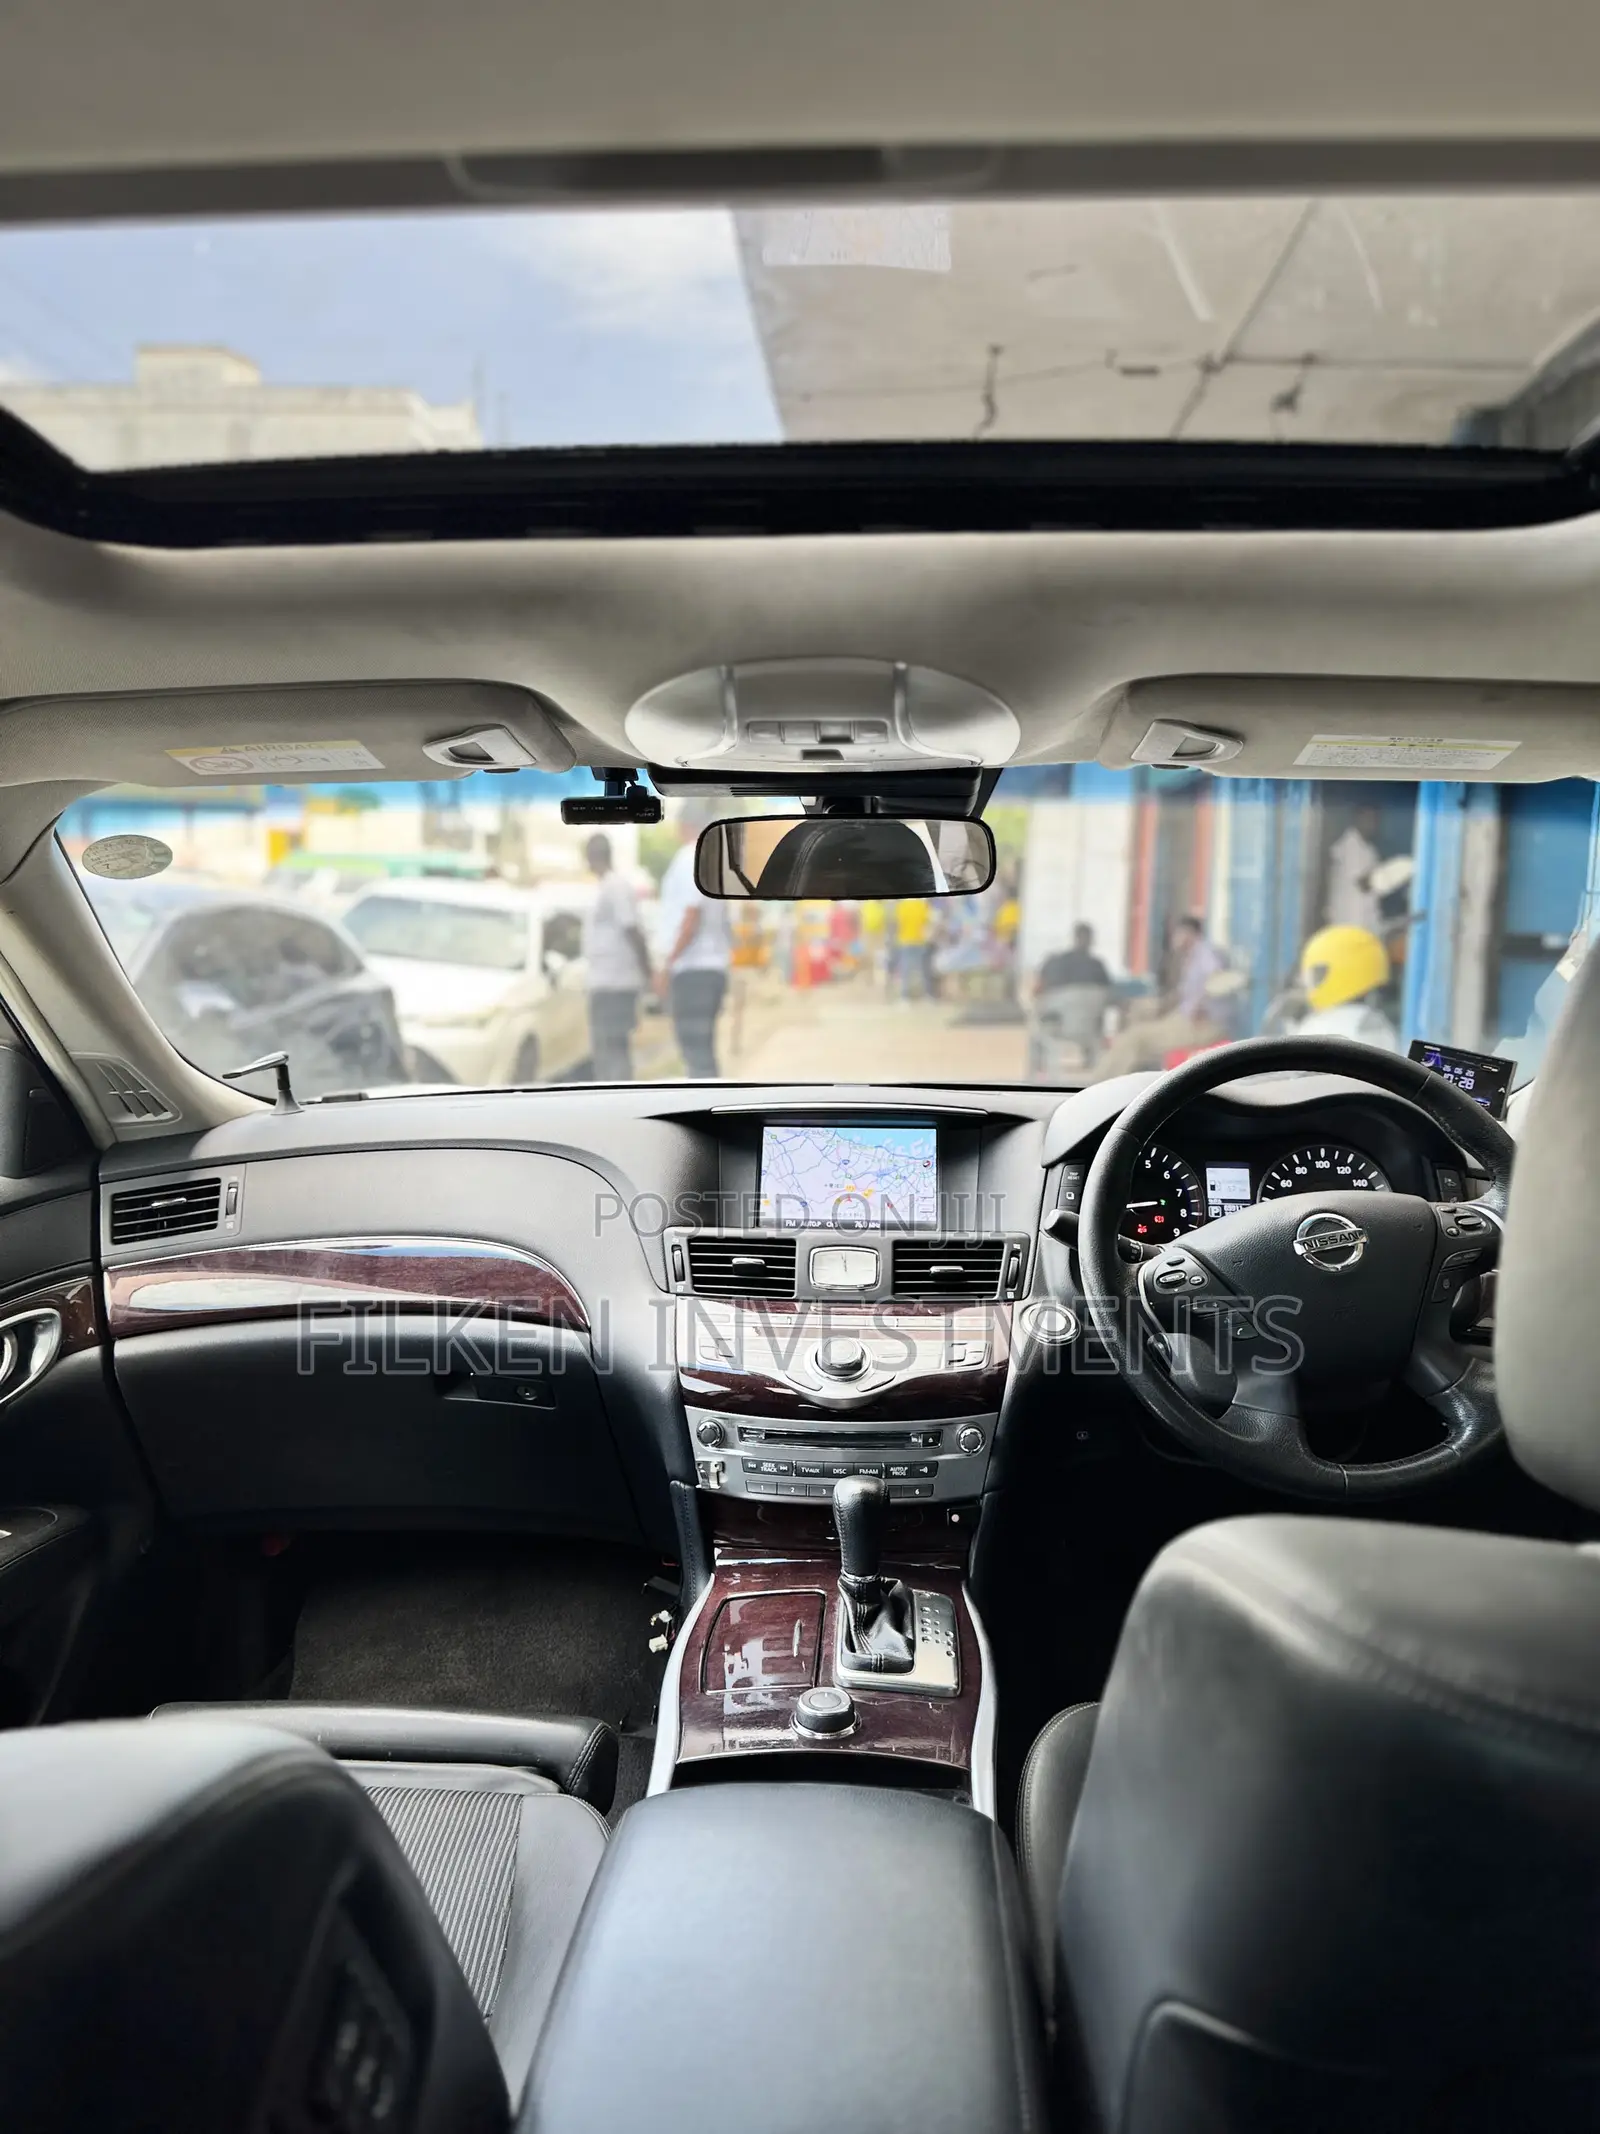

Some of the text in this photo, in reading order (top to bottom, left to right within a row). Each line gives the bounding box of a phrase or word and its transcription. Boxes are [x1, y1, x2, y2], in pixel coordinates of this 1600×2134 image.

[1144, 1160, 1152, 1169] 5
[1315, 1161, 1331, 1169] 100
[1295, 1166, 1308, 1175] 80
[1336, 1166, 1352, 1174] 120
[1163, 1170, 1171, 1180] 6
[1280, 1179, 1293, 1188] 60
[1352, 1179, 1368, 1187] 140
[1176, 1188, 1183, 1198] 7
[1180, 1208, 1187, 1218] 8
[1173, 1227, 1180, 1237] 9
[1302, 1230, 1361, 1251] NISSAN
